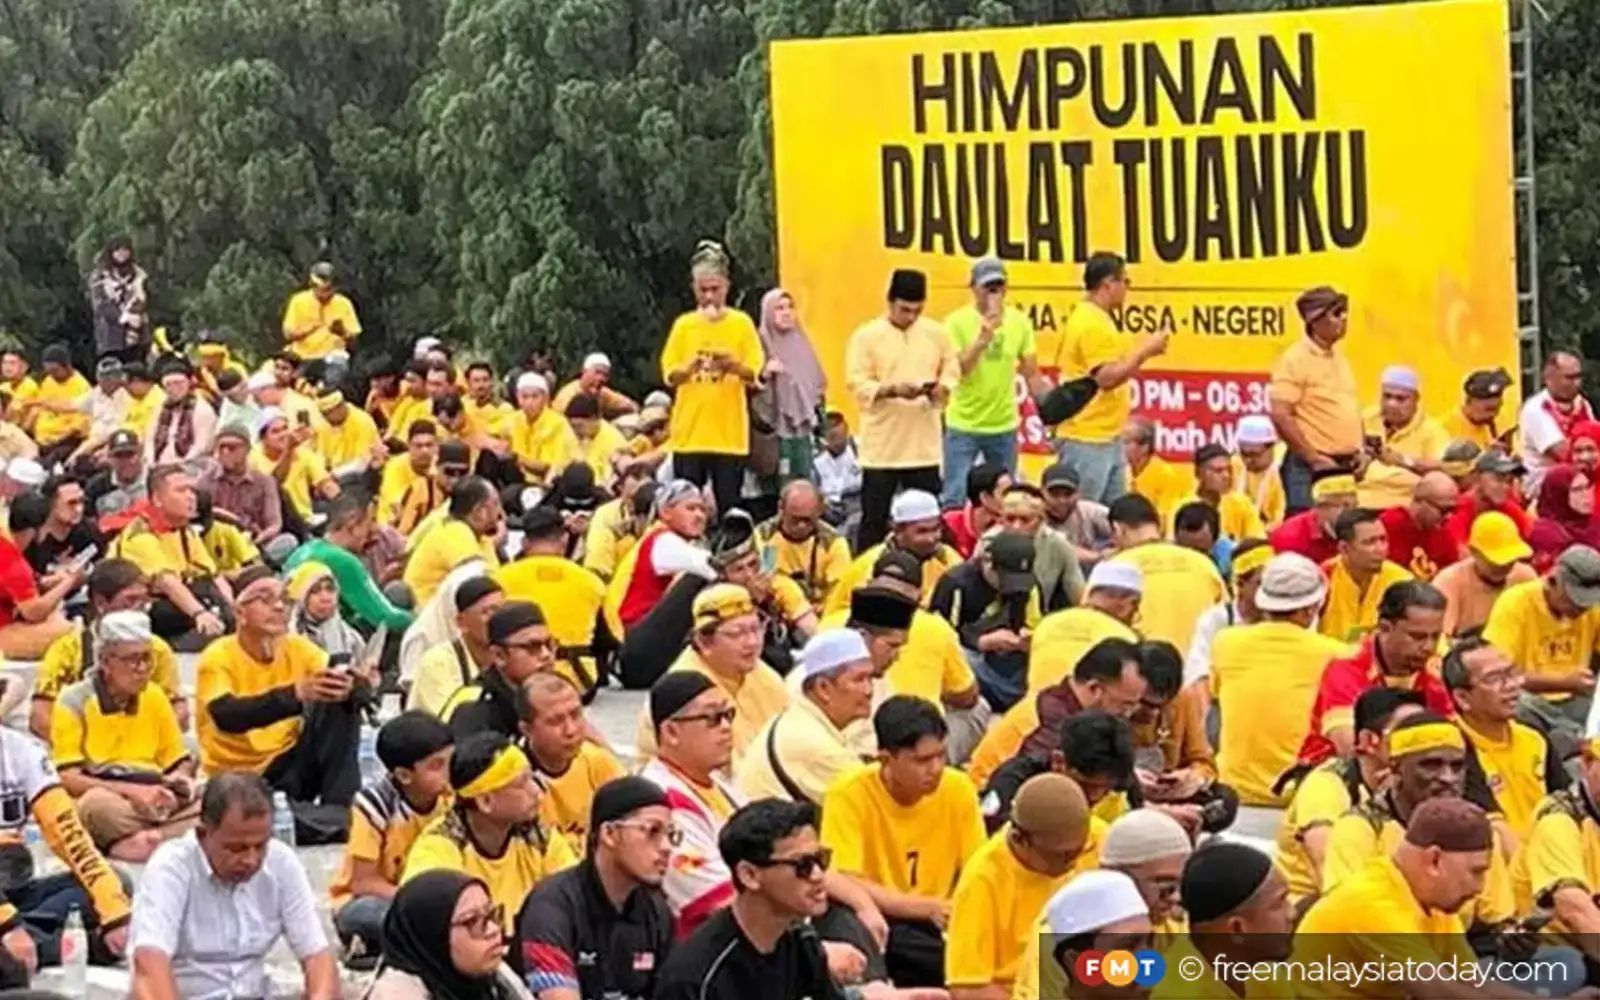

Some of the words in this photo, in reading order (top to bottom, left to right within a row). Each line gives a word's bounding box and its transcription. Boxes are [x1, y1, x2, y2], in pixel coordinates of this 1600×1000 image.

[912, 33, 1316, 133] HIMPUNAN
[881, 140, 1093, 263] DAULAT
[1114, 130, 1368, 263] TUANKU
[1109, 305, 1177, 334] NGSA
[1193, 306, 1285, 336] NEGERI
[1144, 379, 1184, 411] PM
[1154, 420, 1207, 452] hah
